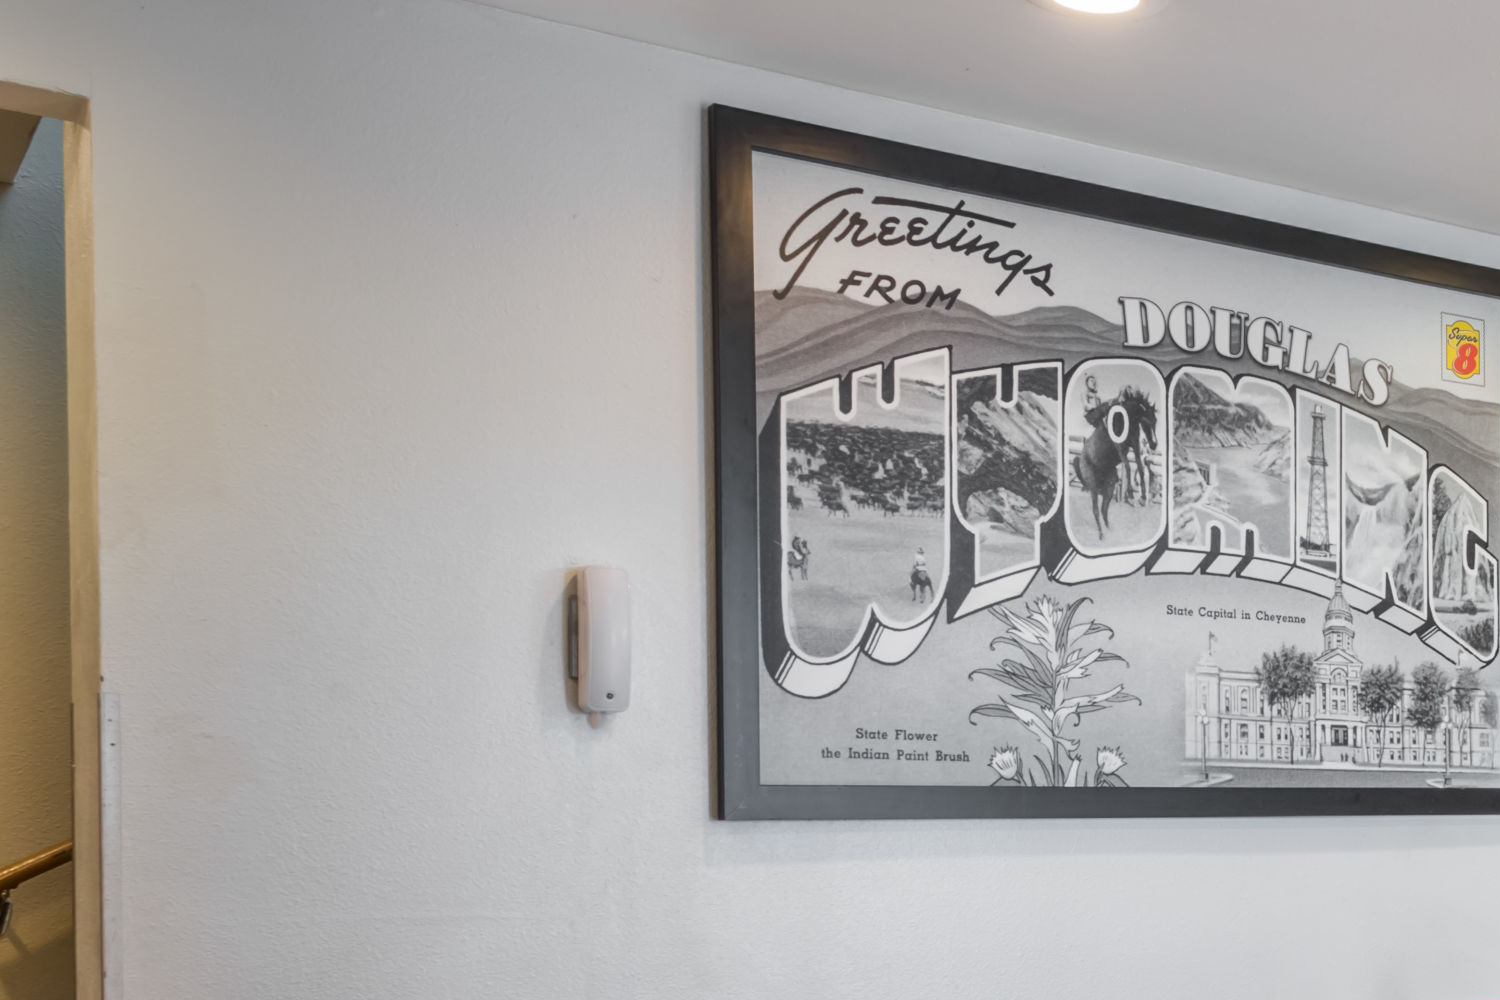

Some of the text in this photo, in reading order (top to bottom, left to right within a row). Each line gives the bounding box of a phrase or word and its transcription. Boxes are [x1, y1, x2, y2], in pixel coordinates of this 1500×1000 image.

[773, 187, 1055, 300] Greetings
[836, 270, 962, 310] FROM
[1118, 296, 1395, 407] DOUGLAS
[1449, 327, 1477, 347] Super
[1453, 343, 1478, 375] 8
[760, 345, 1500, 698] WYOMING
[1166, 605, 1307, 624] State Capital in Cheyenne
[855, 728, 938, 742] State Flower
[821, 747, 970, 763] the Indian Paint Brush
